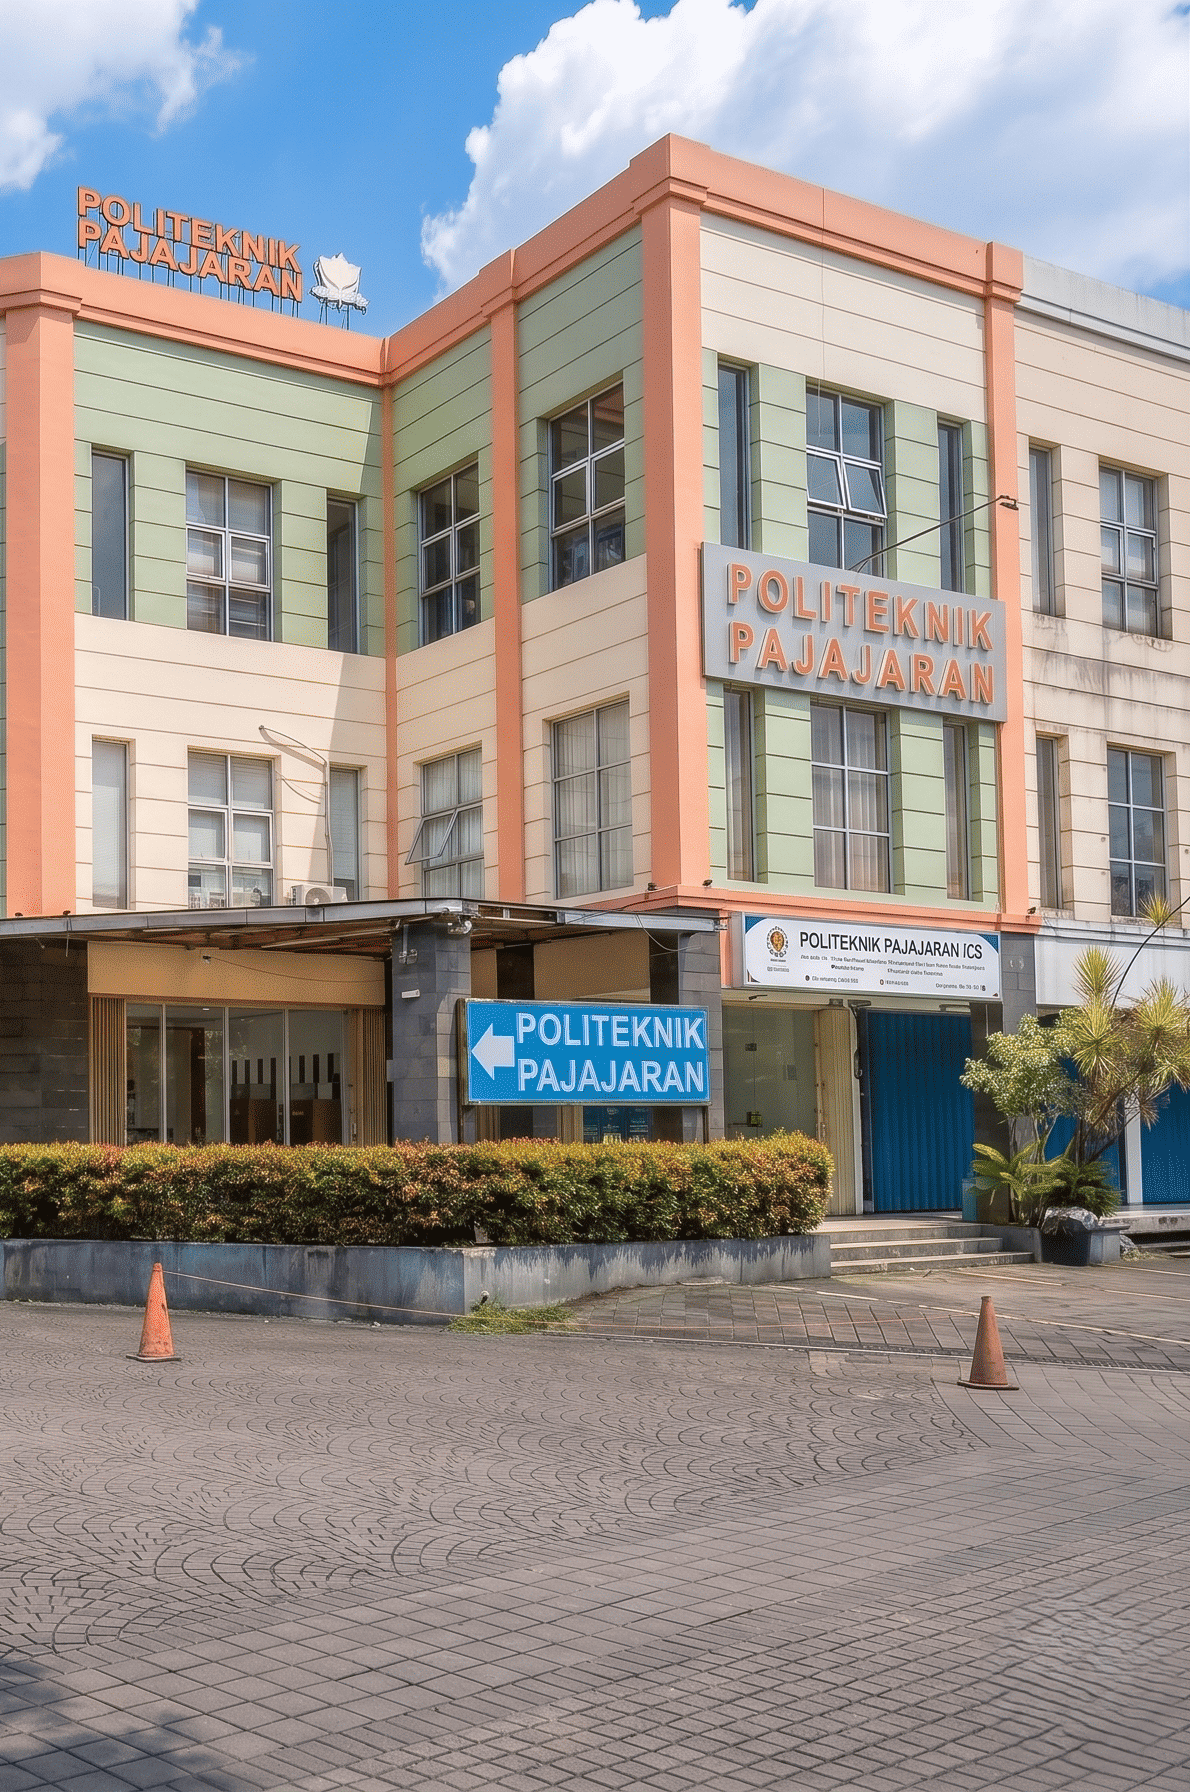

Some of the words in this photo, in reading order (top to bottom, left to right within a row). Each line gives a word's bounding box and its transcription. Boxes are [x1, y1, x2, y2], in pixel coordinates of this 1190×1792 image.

[77, 186, 302, 274] POLITEKNIK
[78, 217, 303, 302] PAJAJARAN
[727, 562, 994, 651] POLITEKNIK
[729, 620, 995, 704] PAJAJARAN
[799, 931, 882, 953] POLITEKNIK
[884, 938, 959, 958] PAJAJARAN
[516, 1012, 705, 1049] POLITEKNIK
[517, 1058, 704, 1092] PAJAJARAN
